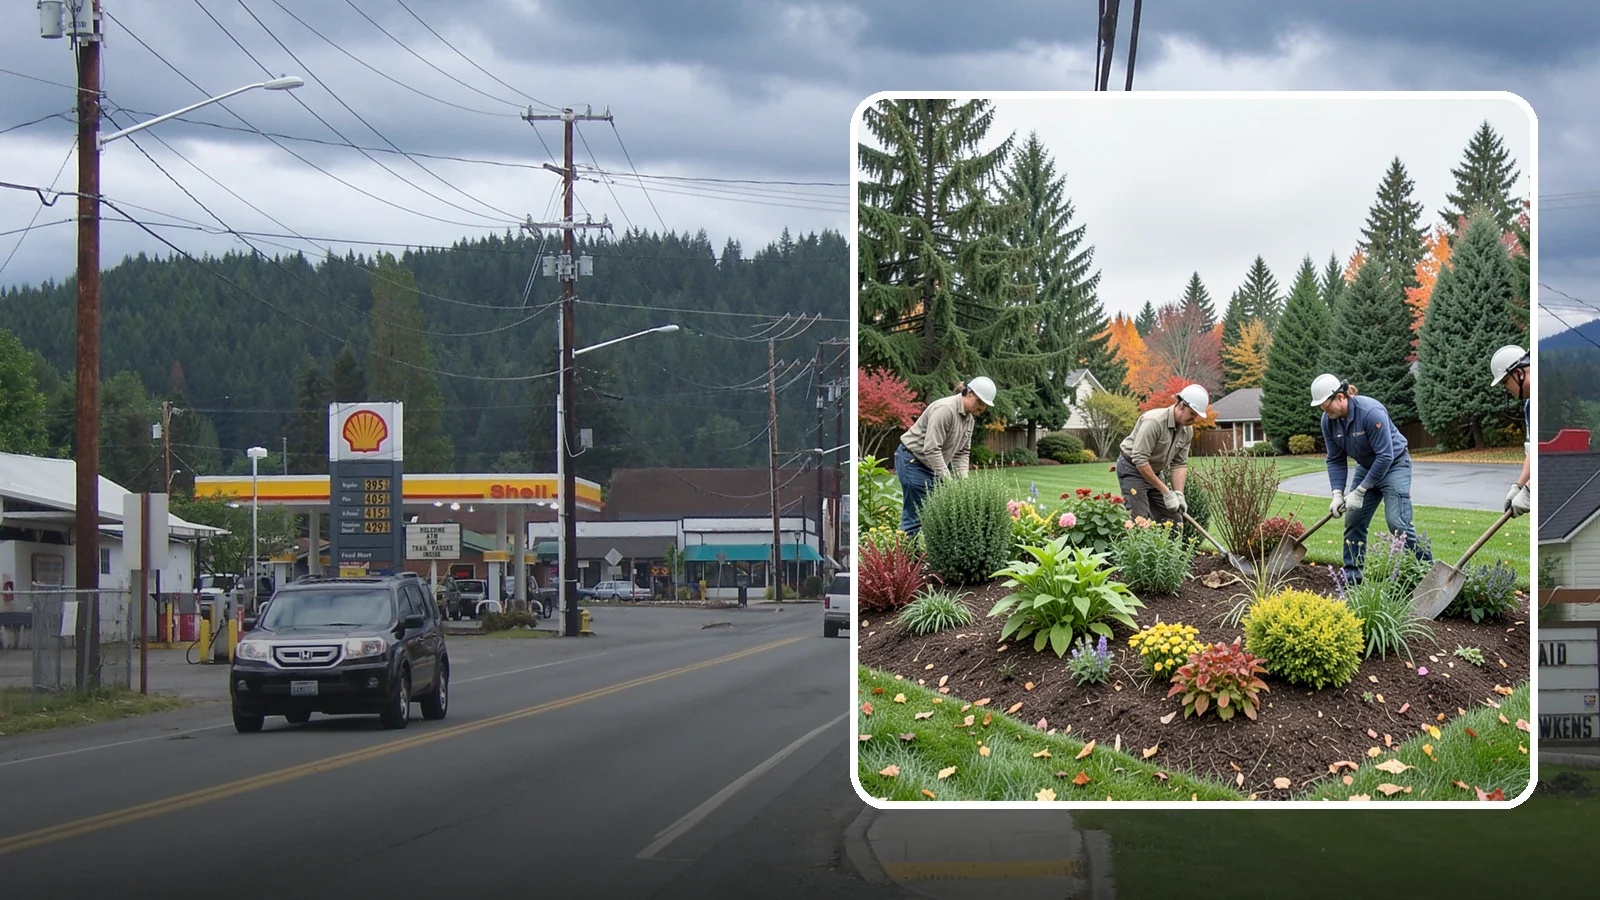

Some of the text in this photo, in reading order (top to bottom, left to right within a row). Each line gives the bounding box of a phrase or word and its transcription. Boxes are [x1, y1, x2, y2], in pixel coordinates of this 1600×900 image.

[365, 480, 383, 490] 395
[490, 484, 547, 499] Shell
[365, 494, 383, 504] 405
[365, 508, 383, 518] 415
[365, 522, 383, 532] 429
[1539, 643, 1567, 666] AID
